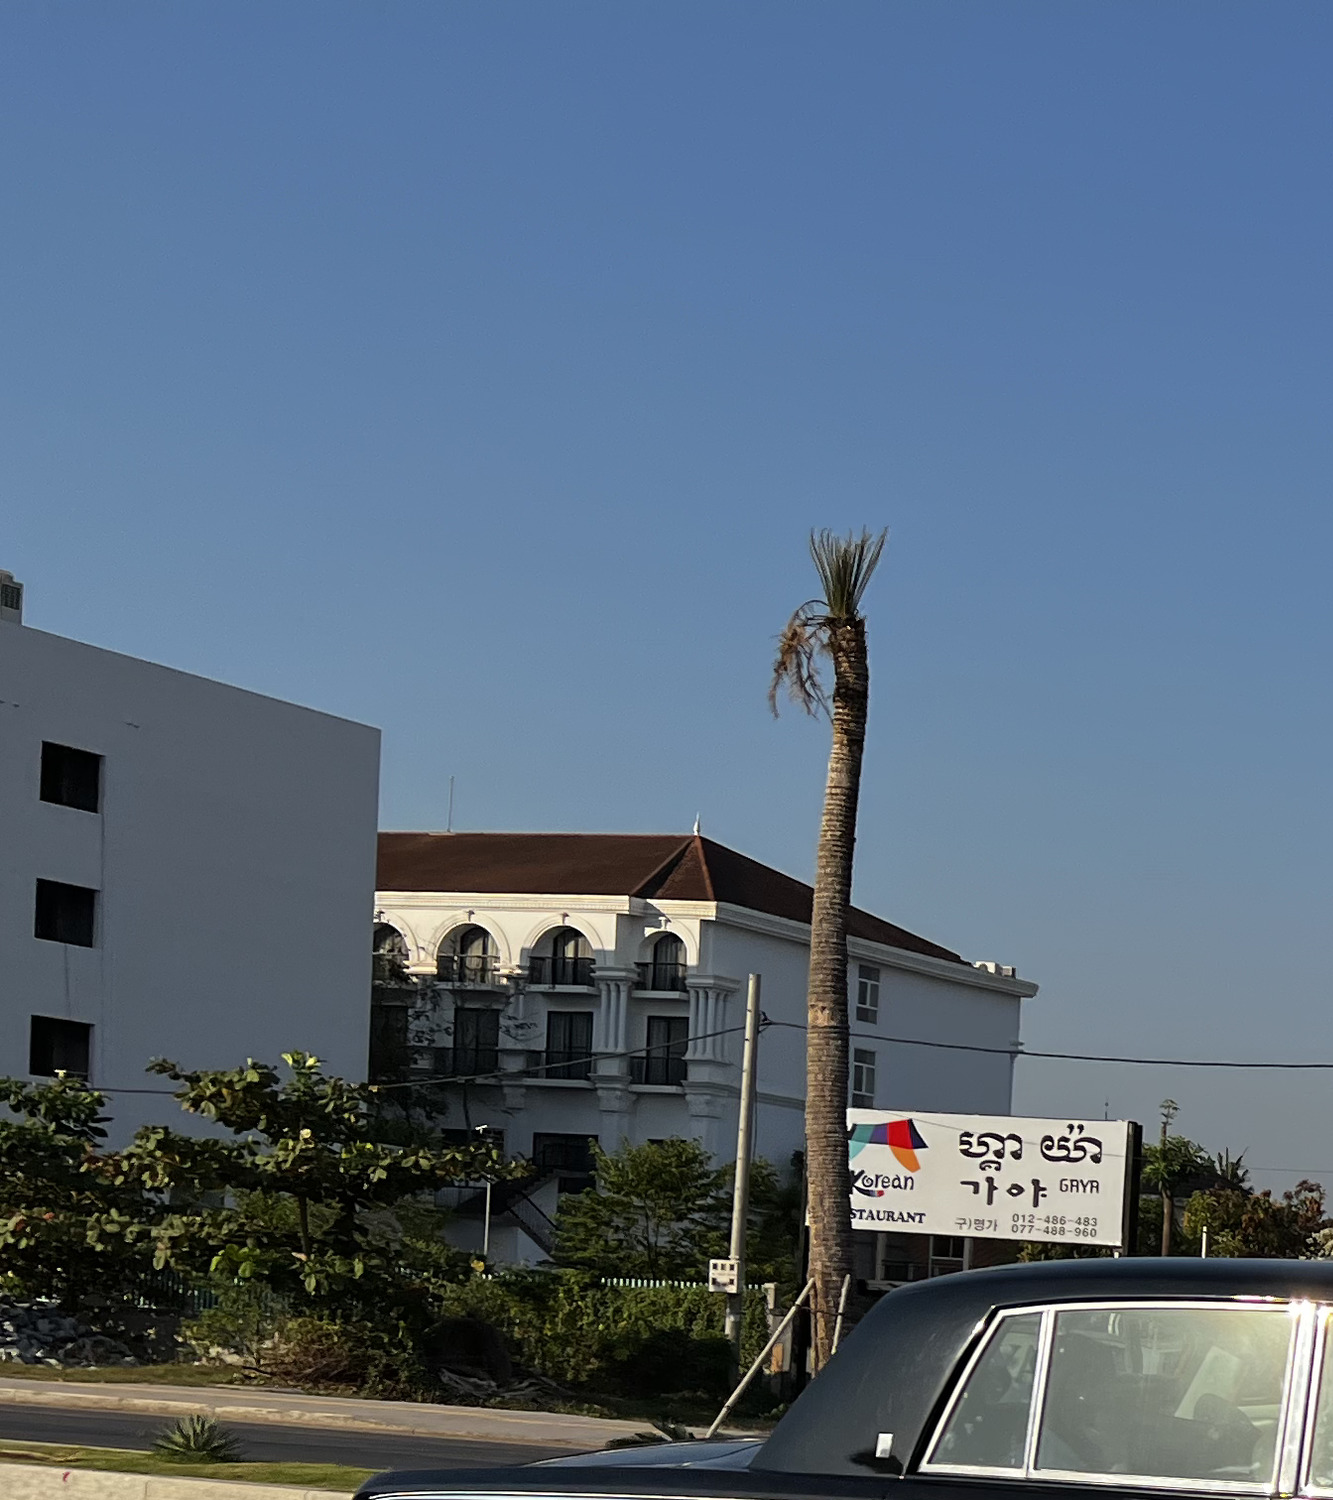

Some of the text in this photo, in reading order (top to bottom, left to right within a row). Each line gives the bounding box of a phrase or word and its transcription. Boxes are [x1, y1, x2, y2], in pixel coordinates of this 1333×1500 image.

[959, 1123, 1103, 1172] ហ្គា យ៉ា
[960, 1176, 1048, 1209] 가야
[1059, 1178, 1100, 1194] GAYA
[954, 1217, 998, 1232] 구)명가
[1011, 1213, 1098, 1227] 012-486-483
[1011, 1223, 1098, 1238] 077-488-960
